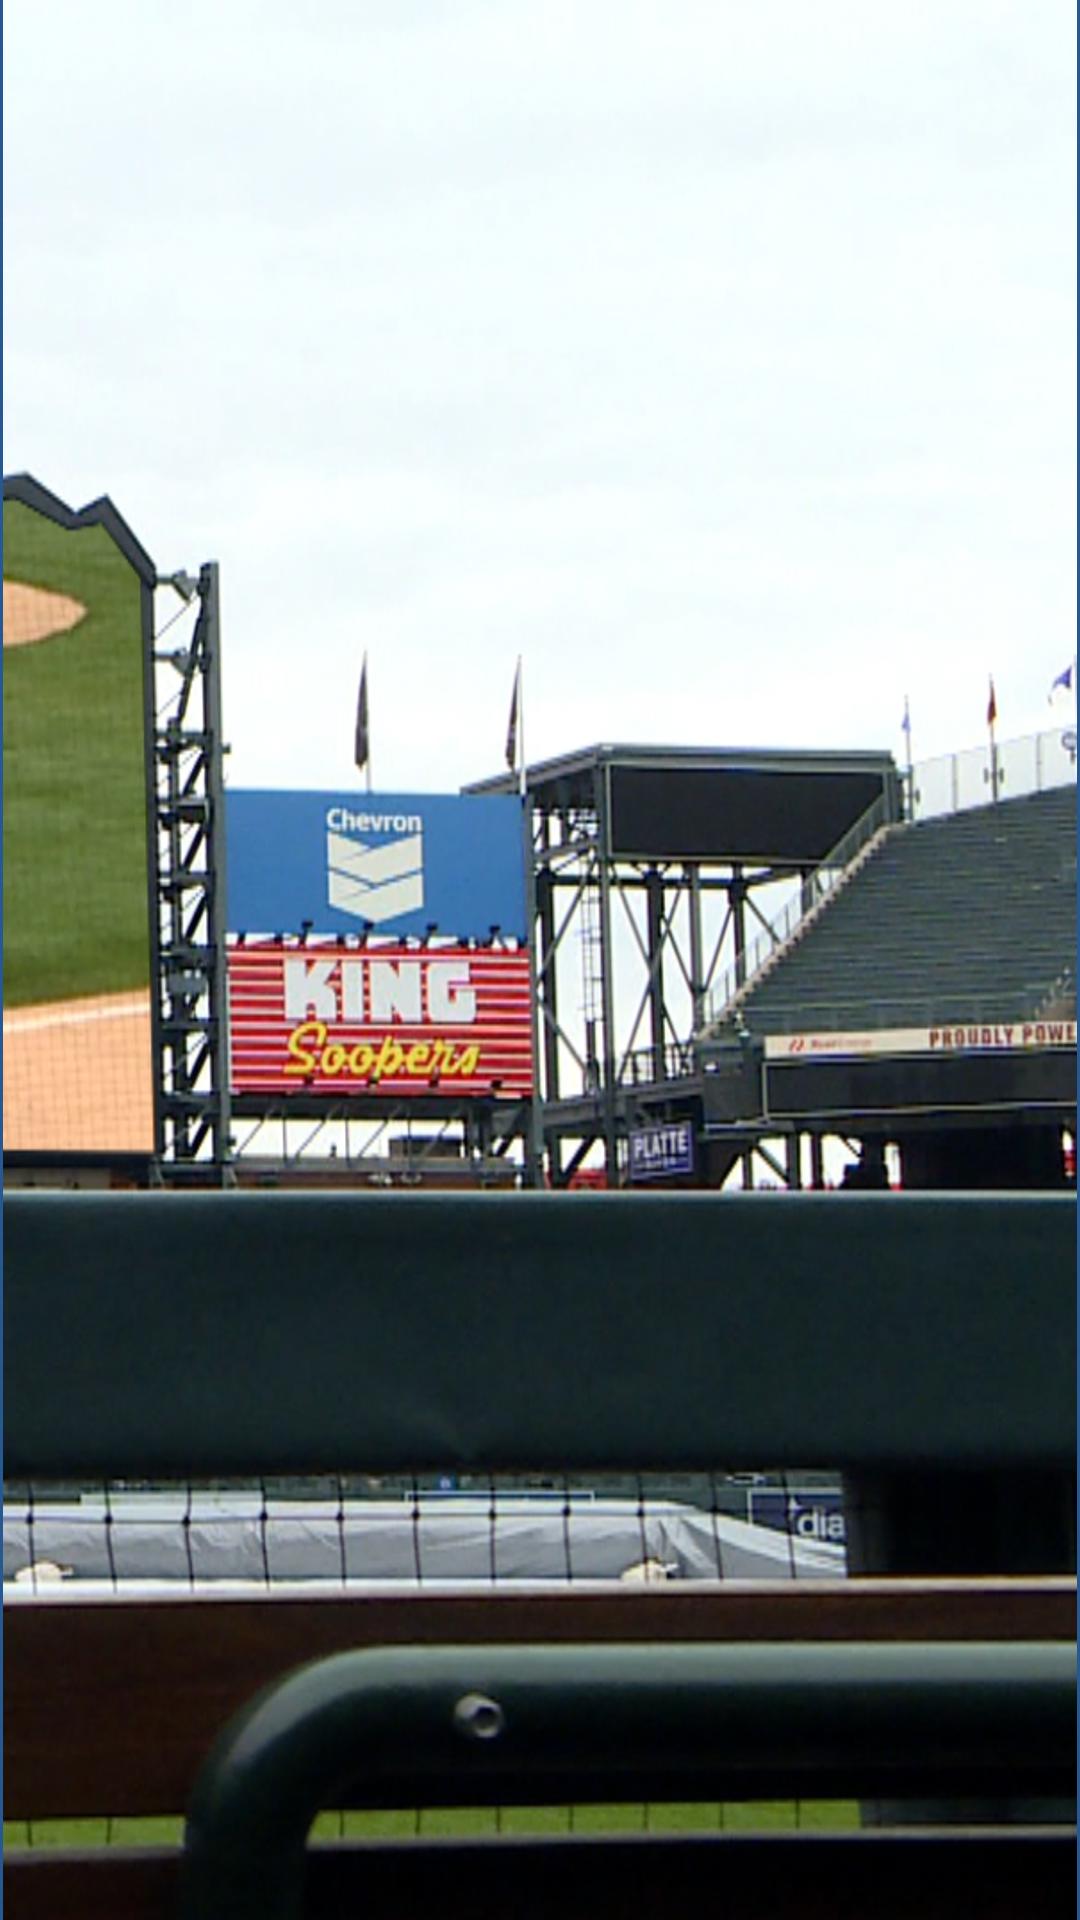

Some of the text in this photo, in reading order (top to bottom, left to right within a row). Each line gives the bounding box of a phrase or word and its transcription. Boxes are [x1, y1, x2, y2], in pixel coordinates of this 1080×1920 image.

[327, 809, 422, 832] Chevron
[283, 958, 477, 1023] KING
[284, 1022, 479, 1079] Soopers
[929, 1025, 1014, 1049] PROUDLY
[634, 1129, 688, 1159] PLATTE
